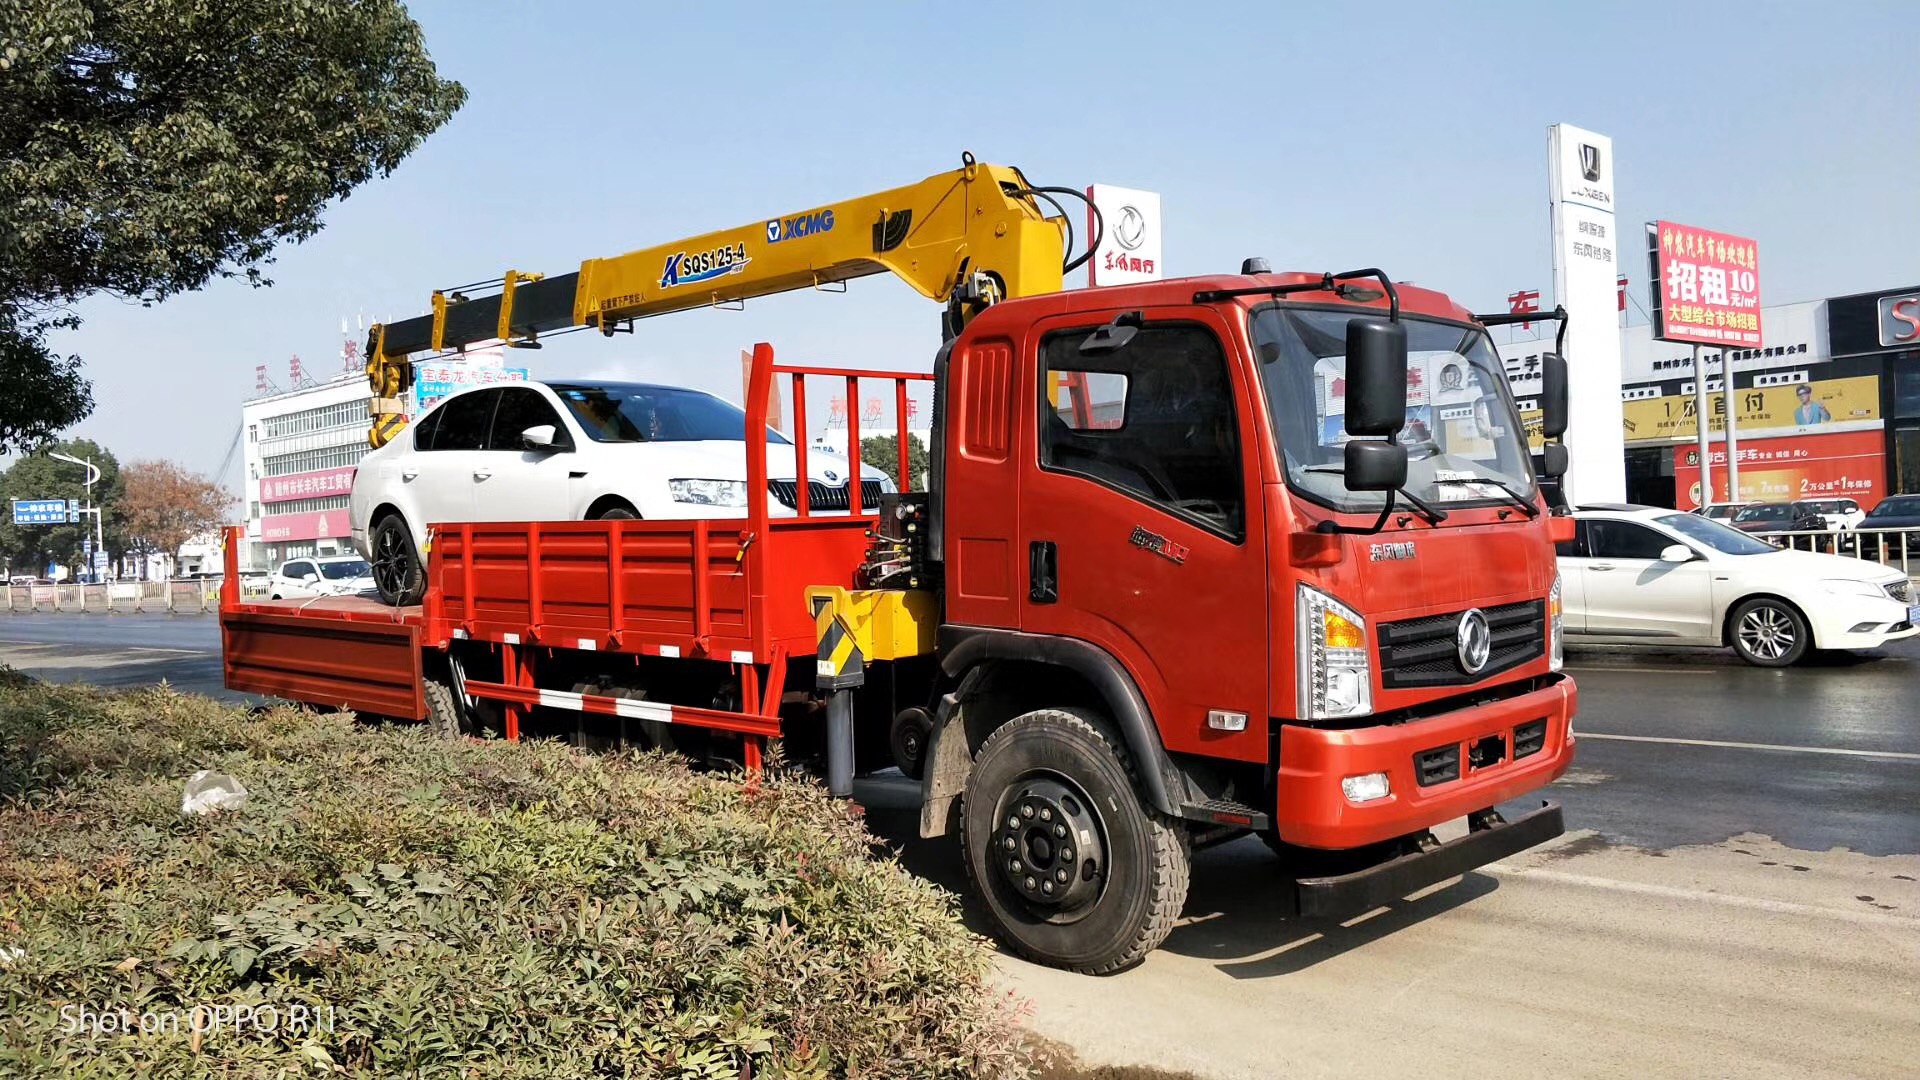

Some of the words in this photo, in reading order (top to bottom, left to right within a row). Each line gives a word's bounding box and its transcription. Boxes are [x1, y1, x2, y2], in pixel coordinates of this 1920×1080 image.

[783, 210, 834, 240] XCMG
[1667, 260, 1729, 306] 招租
[1729, 270, 1755, 293] 10
[1669, 304, 1759, 331] 大型综合市场招租
